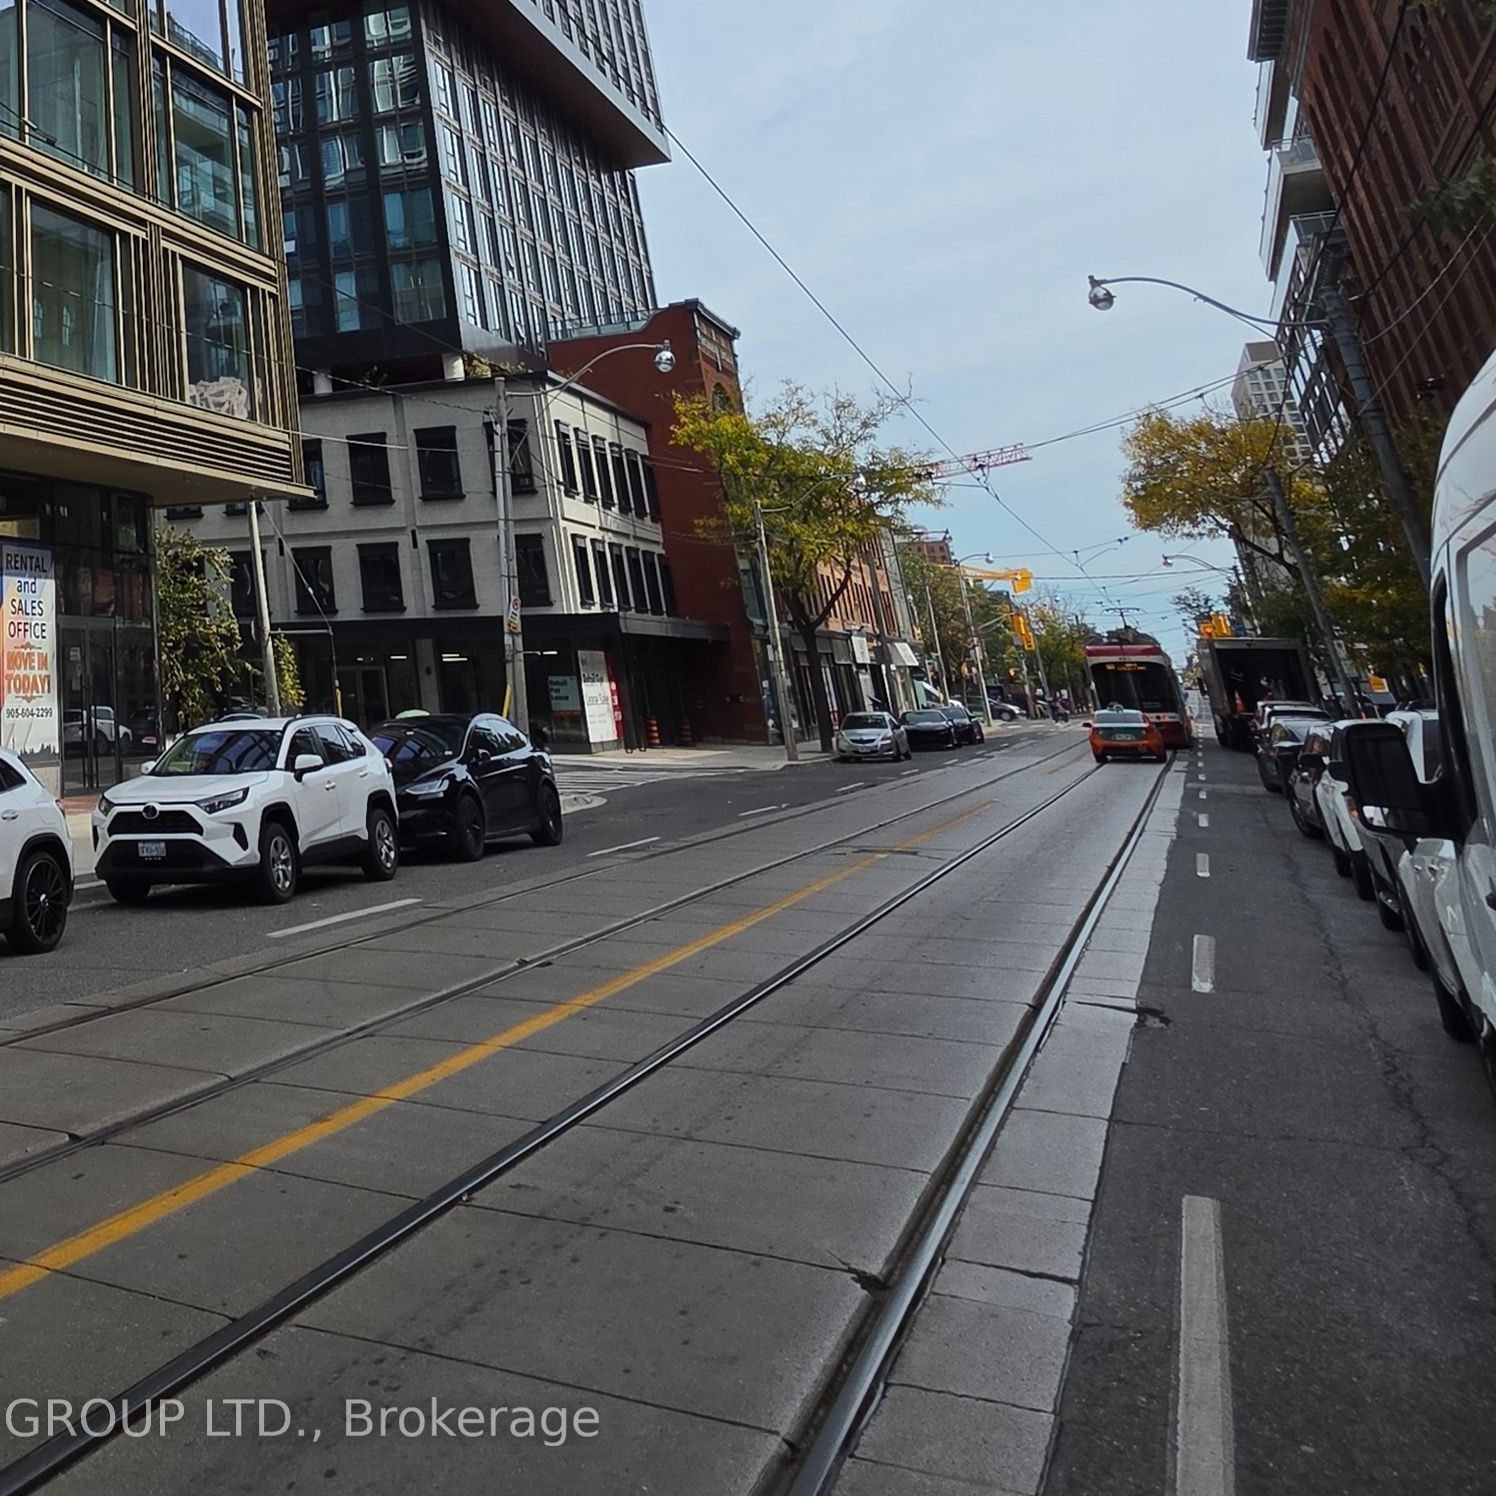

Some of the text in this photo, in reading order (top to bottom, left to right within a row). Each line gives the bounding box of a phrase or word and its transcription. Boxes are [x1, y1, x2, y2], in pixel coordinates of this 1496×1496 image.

[6, 553, 47, 573] RENTAL
[16, 577, 37, 594] and
[10, 598, 44, 616] SALES
[8, 621, 47, 640] OFFICE
[6, 652, 35, 671] MOVE
[37, 652, 48, 671] IN
[5, 674, 51, 694] TODAY!
[6, 707, 53, 719] 905-604-2299
